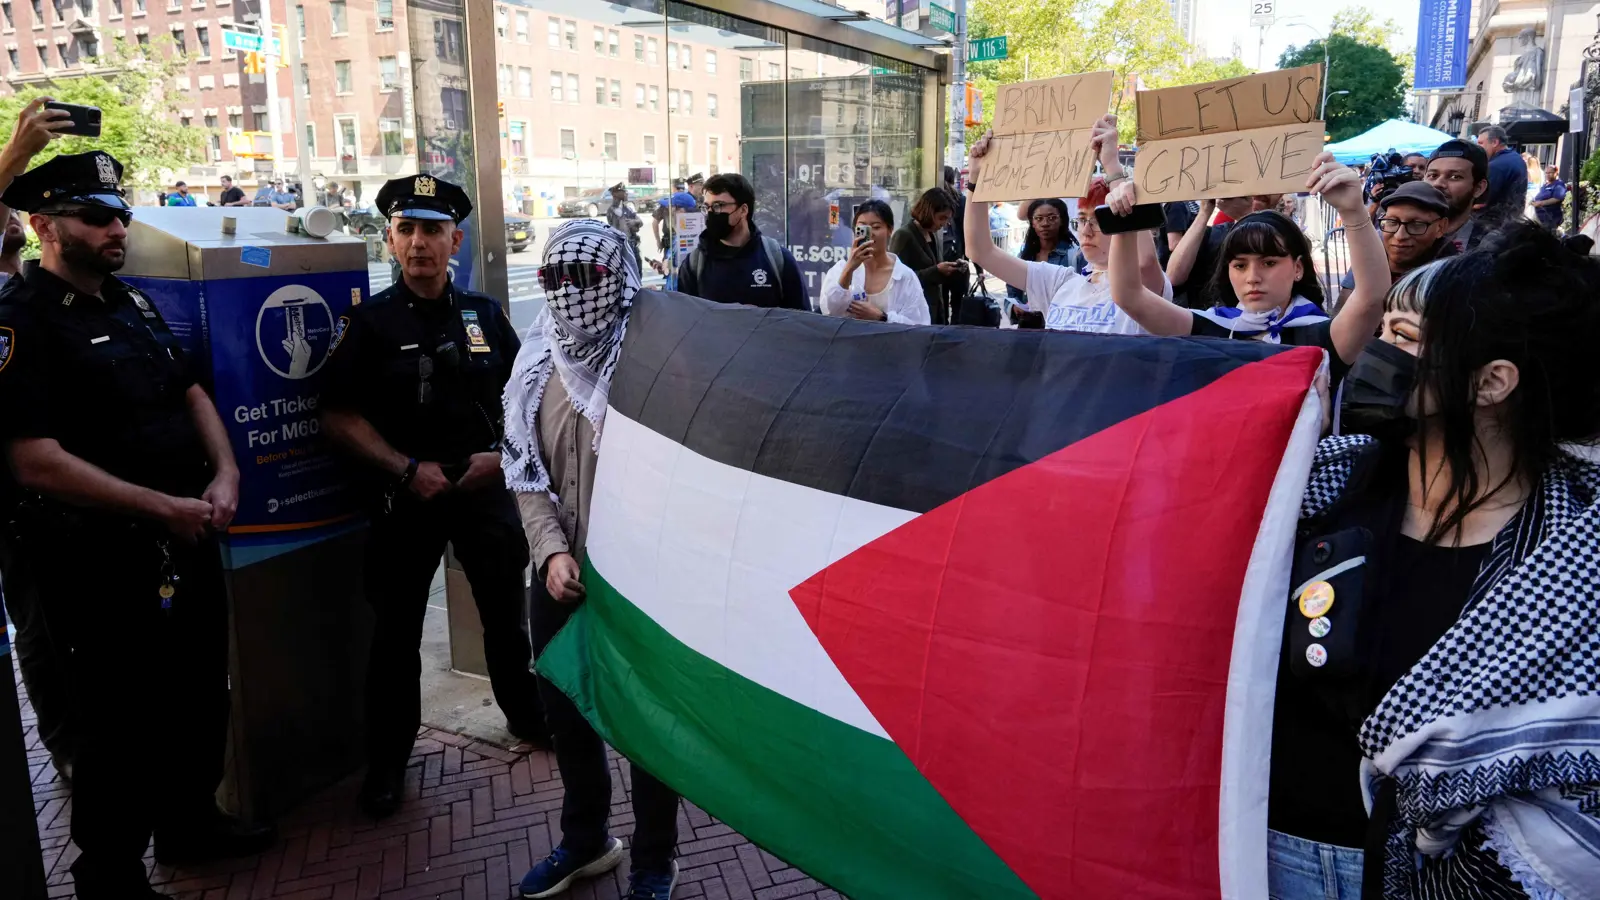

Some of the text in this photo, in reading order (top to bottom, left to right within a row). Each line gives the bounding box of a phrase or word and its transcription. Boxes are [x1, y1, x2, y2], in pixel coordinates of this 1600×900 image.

[1254, 2, 1273, 15] 25
[970, 42, 979, 59] W
[982, 40, 996, 58] 116
[1434, 0, 1446, 83] COLUMBIA UNIVERSITY
[1001, 77, 1083, 129] BRING
[1157, 75, 1317, 137] LET US
[992, 129, 1075, 165] THEM
[1142, 130, 1314, 195] GRIEVE
[981, 145, 1090, 193] HOME NOW
[234, 391, 321, 424] Get Ticke
[247, 417, 320, 449] For M60
[256, 450, 288, 465] Before
[1307, 653, 1322, 664] GAZA
